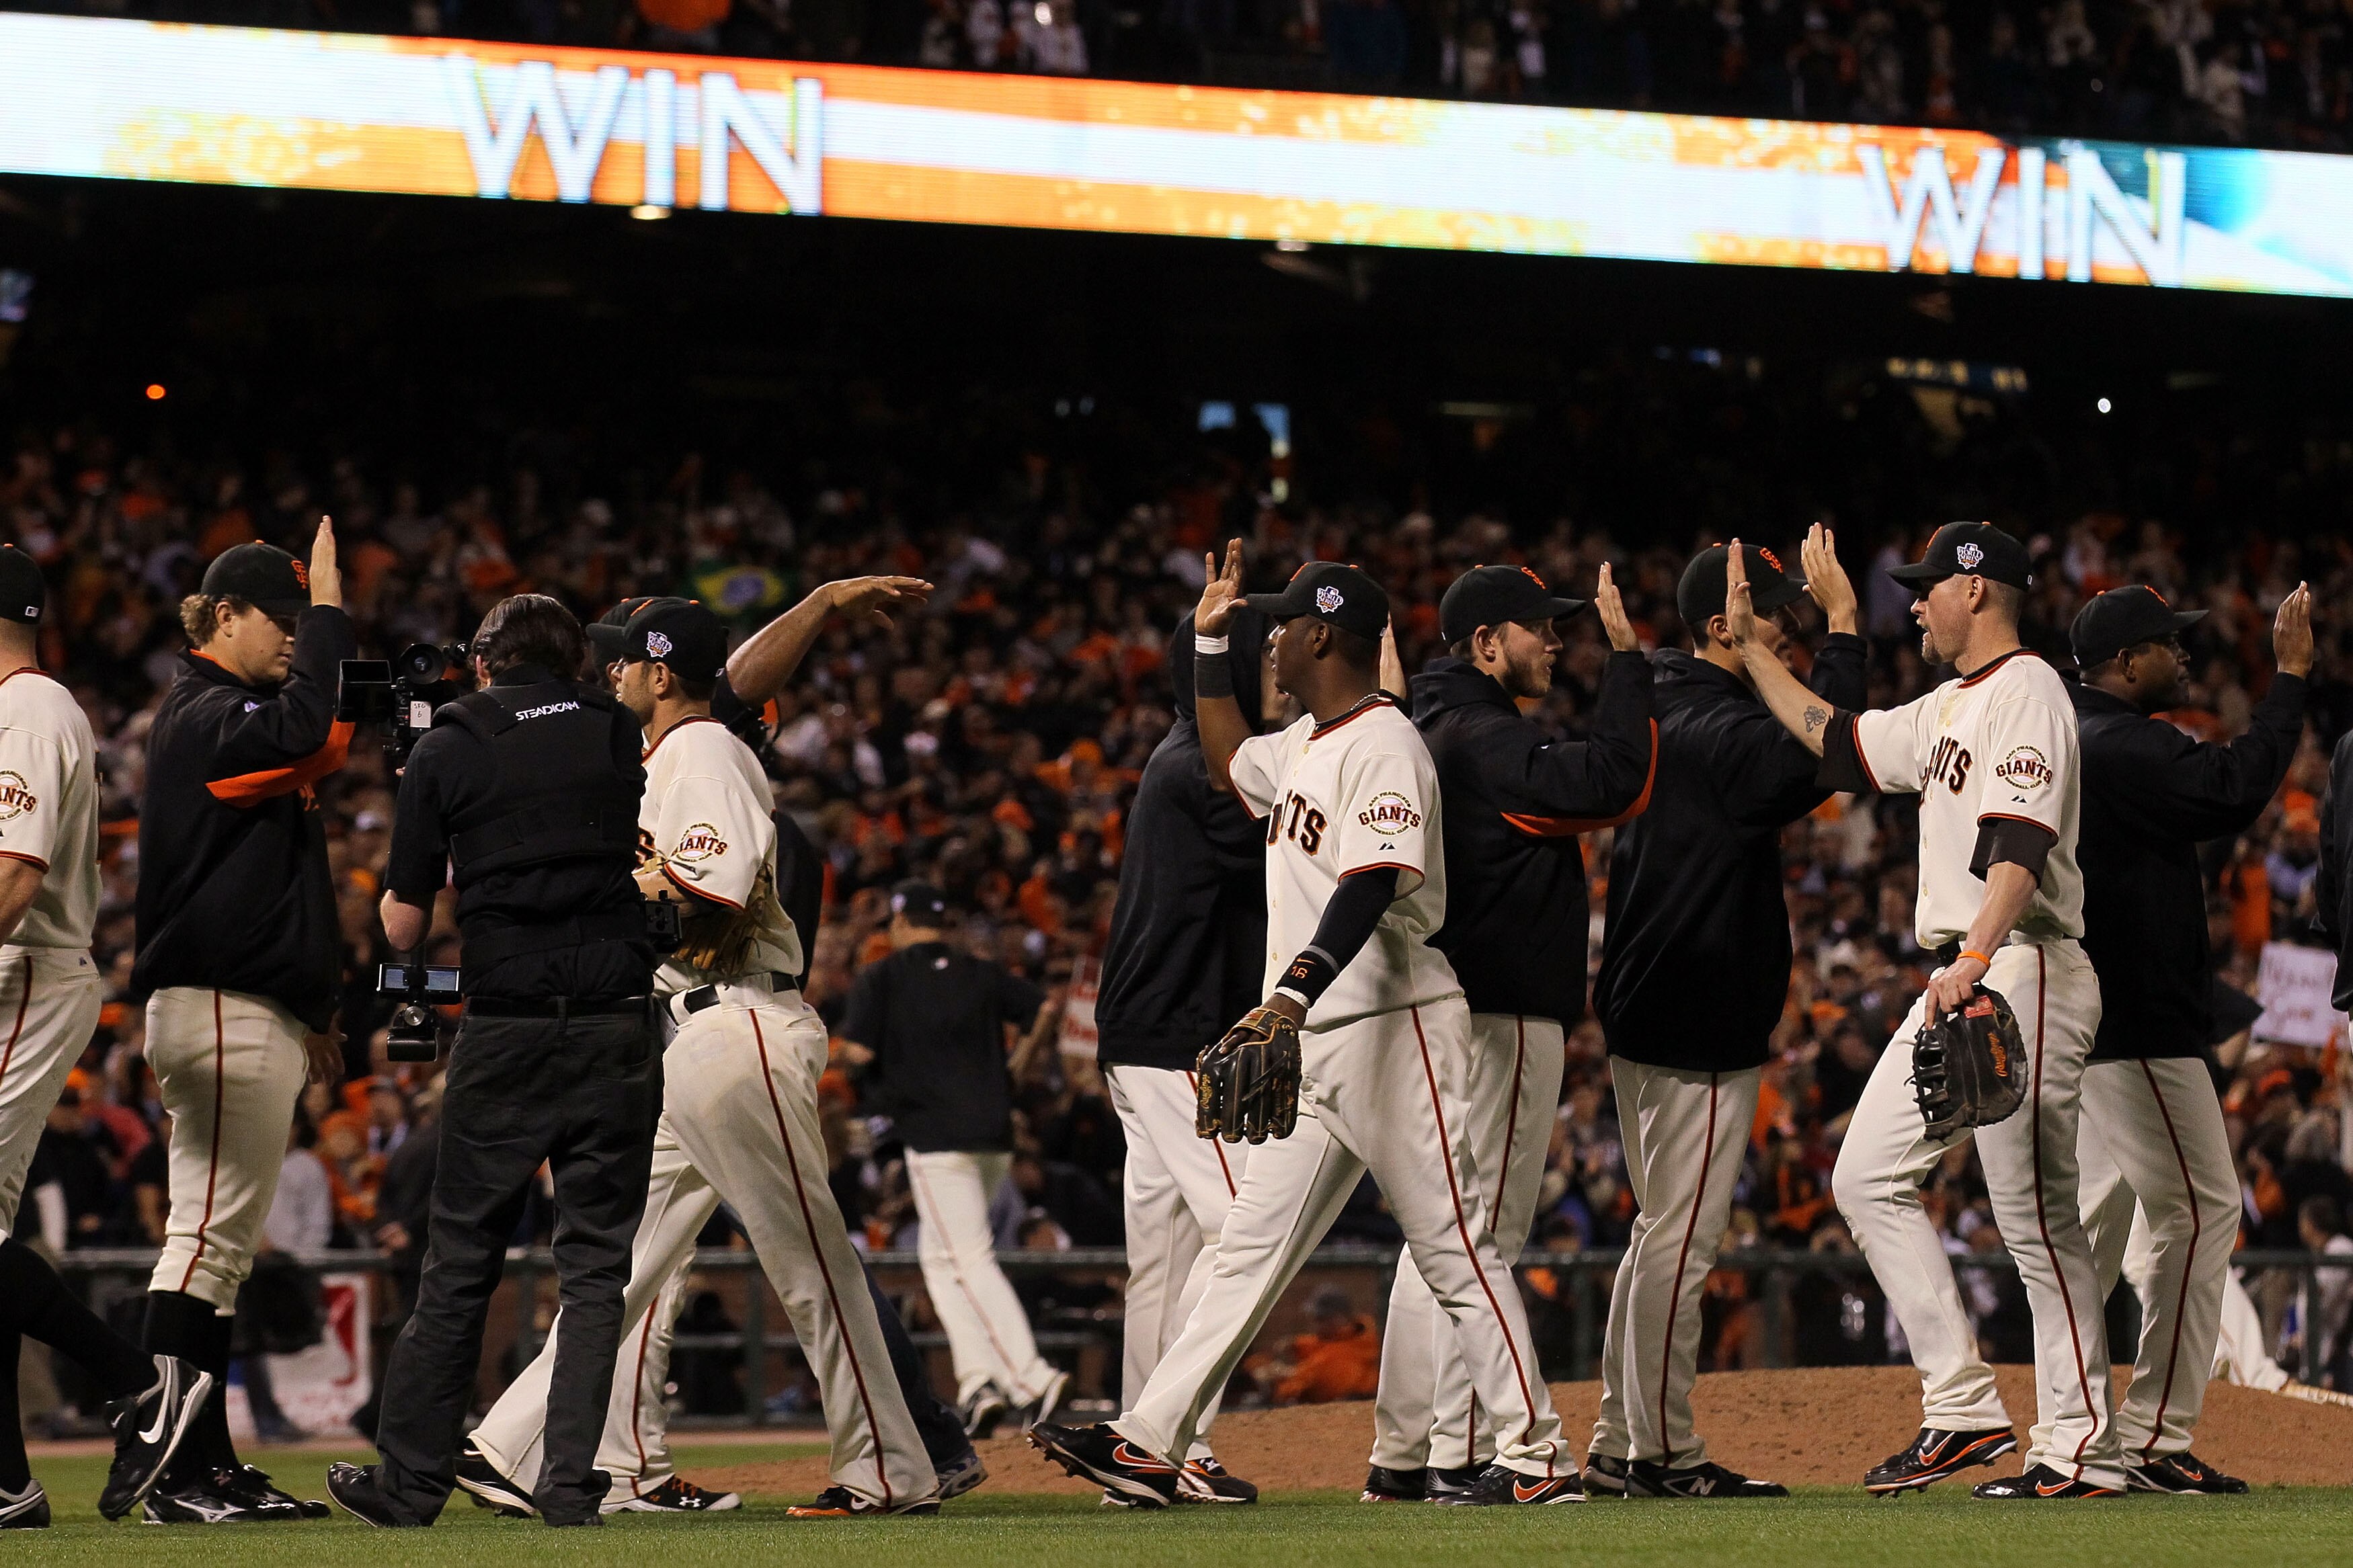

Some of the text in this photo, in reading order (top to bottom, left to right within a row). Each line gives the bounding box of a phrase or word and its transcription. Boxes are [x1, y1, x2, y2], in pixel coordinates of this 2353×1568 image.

[444, 55, 822, 216] WIN
[1855, 145, 2186, 287] WIN
[515, 701, 580, 720] STEADICAM
[2017, 745, 2046, 764] FRANCISCO
[1995, 760, 2052, 785] GIANTS
[2005, 777, 2042, 789] BASEBALL CLUB
[1368, 791, 1411, 808] SAN FRANCISCO
[1358, 807, 1421, 828] GIANTS
[1369, 824, 1409, 835] BASEBALL CLUB
[1291, 965, 1308, 979] 16
